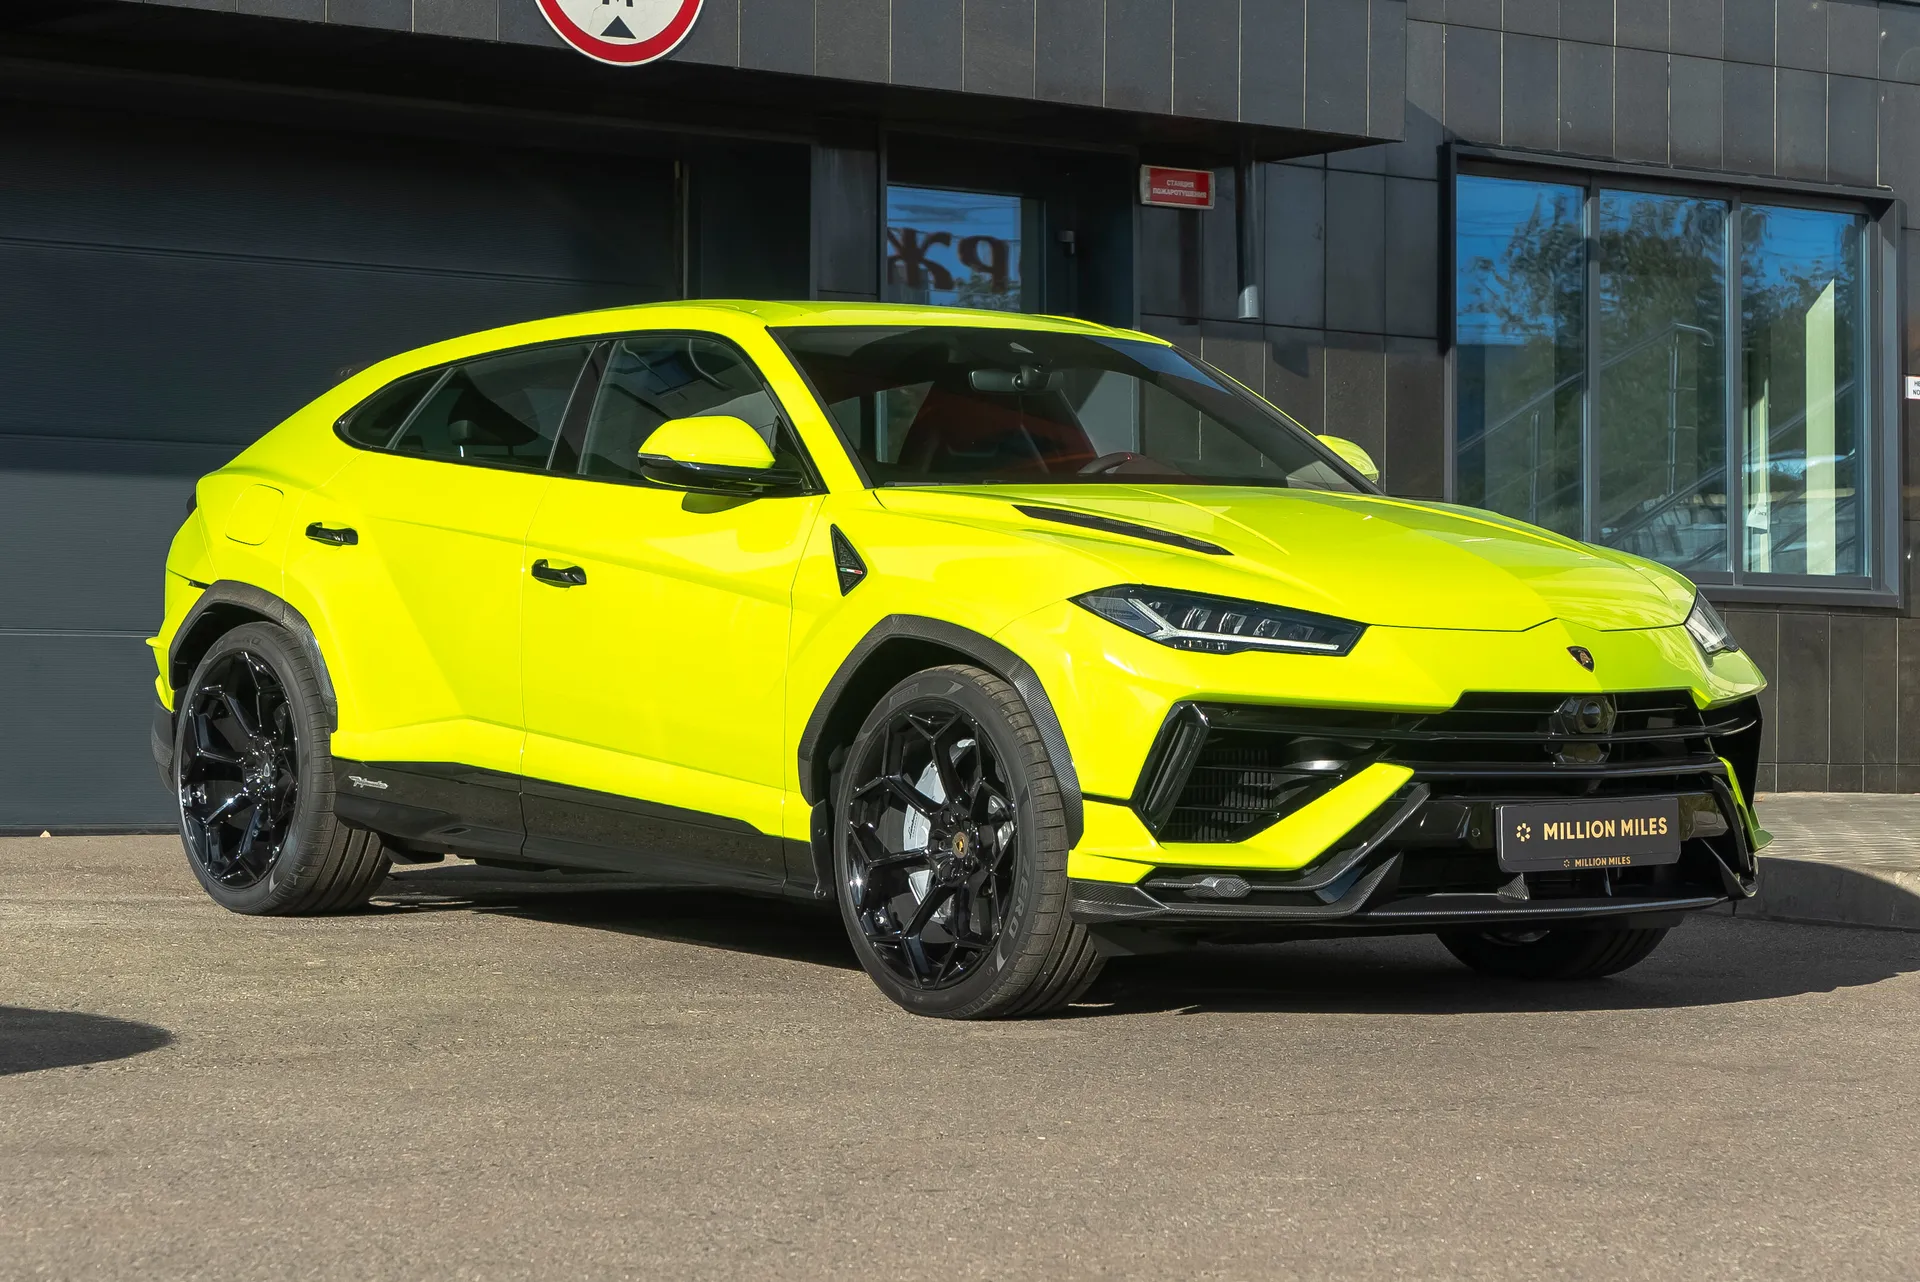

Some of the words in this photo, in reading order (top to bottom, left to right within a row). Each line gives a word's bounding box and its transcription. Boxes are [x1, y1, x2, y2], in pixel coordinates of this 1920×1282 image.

[1543, 819, 1616, 841] MILLION
[1620, 816, 1668, 837] MILES
[1574, 857, 1607, 868] MILLION
[1608, 856, 1631, 866] MILES
[1008, 855, 1031, 939] ZERO
